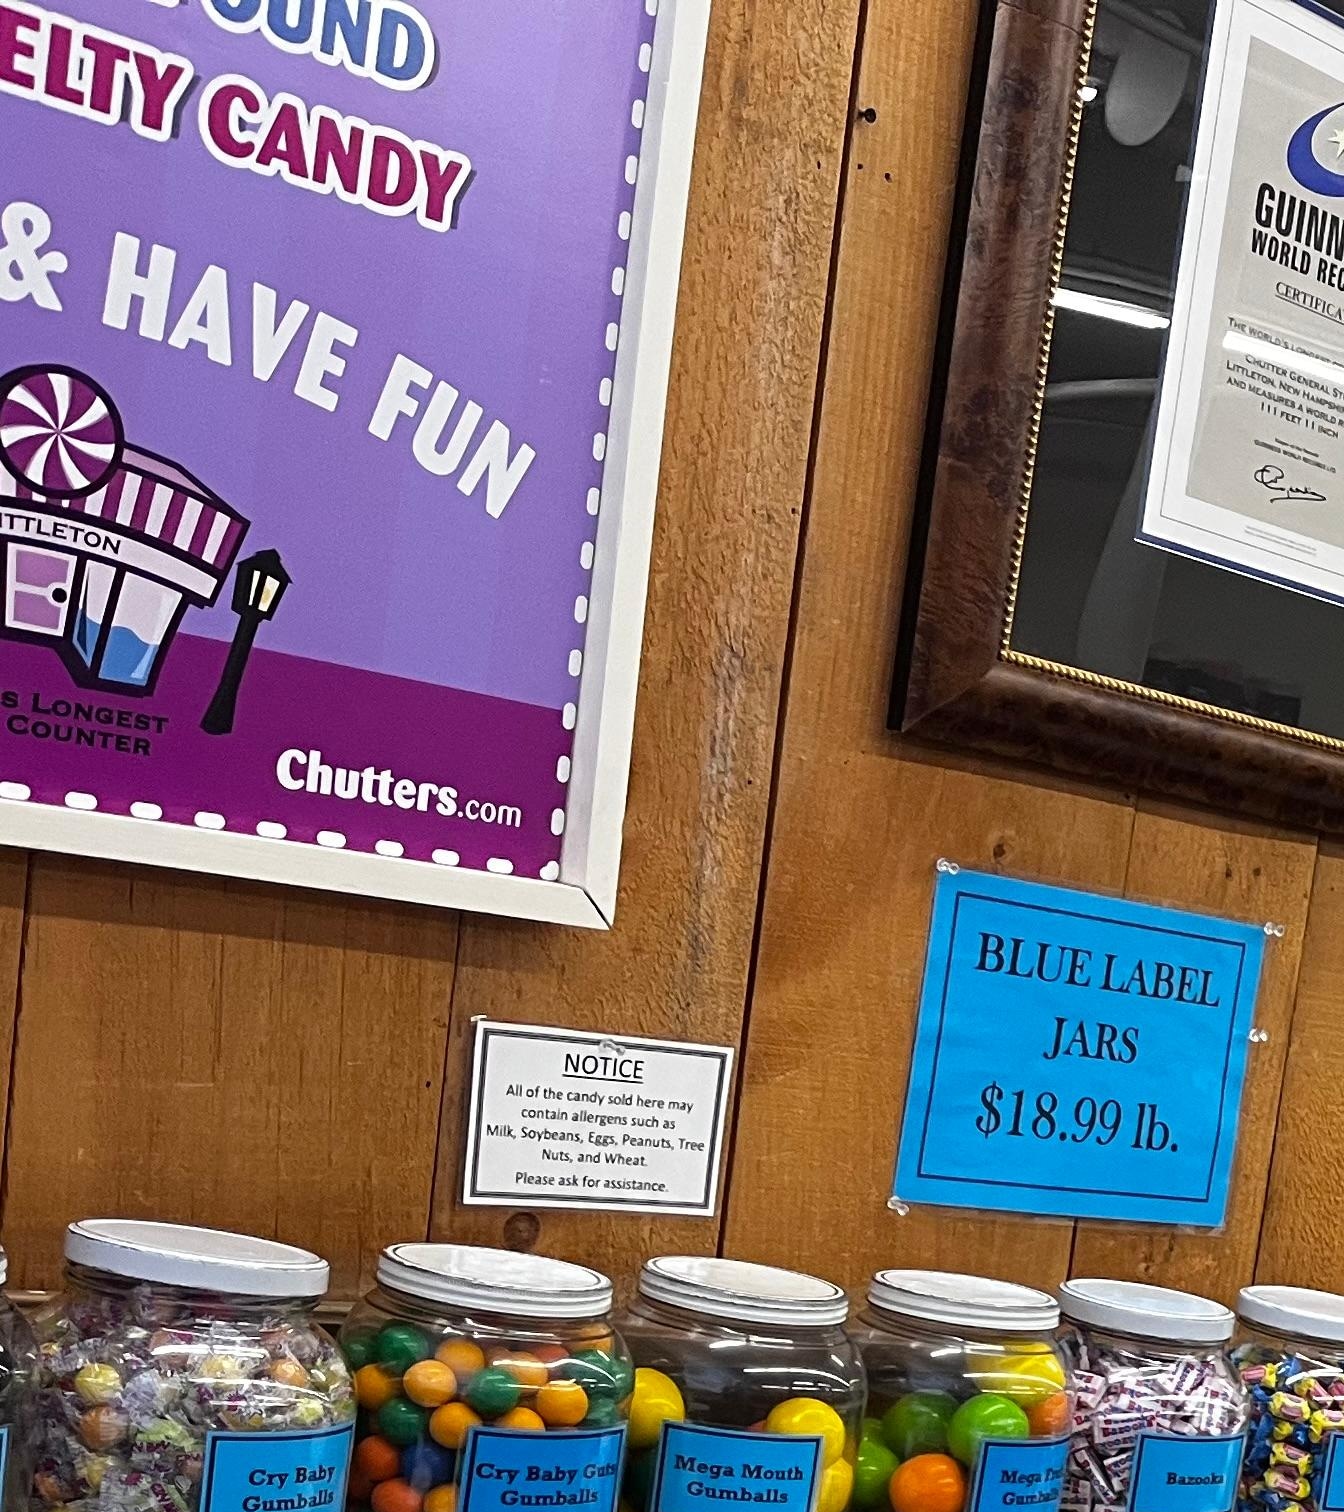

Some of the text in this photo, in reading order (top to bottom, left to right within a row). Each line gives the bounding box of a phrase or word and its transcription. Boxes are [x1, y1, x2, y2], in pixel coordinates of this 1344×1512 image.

[207, 84, 462, 224] CANDY
[1251, 228, 1312, 276] WORLD
[1228, 317, 1247, 332] THE
[0, 201, 536, 519] & HAVE FUN
[1245, 354, 1287, 377] CHUTTER
[1289, 371, 1330, 395] GENERAL
[1226, 376, 1247, 391] AND
[1305, 407, 1336, 425] WORLD
[1279, 382, 1300, 397] NEW
[1280, 409, 1302, 425] FEET
[31, 692, 169, 734] LONGEST
[6, 715, 152, 756] COUNTER
[276, 747, 521, 828] Chutters.com
[976, 932, 1221, 1008] BLUE LABEL
[1042, 1017, 1140, 1067] JARS
[564, 1053, 645, 1080] NOTICE
[506, 1084, 694, 1114] All of the candy sold here may
[521, 1107, 676, 1130] contain allergens such as
[975, 1082, 1179, 1154] $18.99 lb.
[486, 1124, 705, 1152] Milk, Soybeans, Eggs, Peanuts, Tree
[542, 1149, 648, 1167] Nuts, and Wheat.
[515, 1172, 669, 1193] Please ask for assistance.
[249, 1463, 335, 1489] Cry Baby
[475, 1463, 520, 1485] Cry
[525, 1465, 578, 1485] Baby
[674, 1454, 804, 1481] Mega Mouth
[1000, 1470, 1042, 1487] Mega
[1166, 1472, 1225, 1487] Bazooka
[501, 1488, 599, 1507] Gumballs
[686, 1480, 789, 1504] Gumballs
